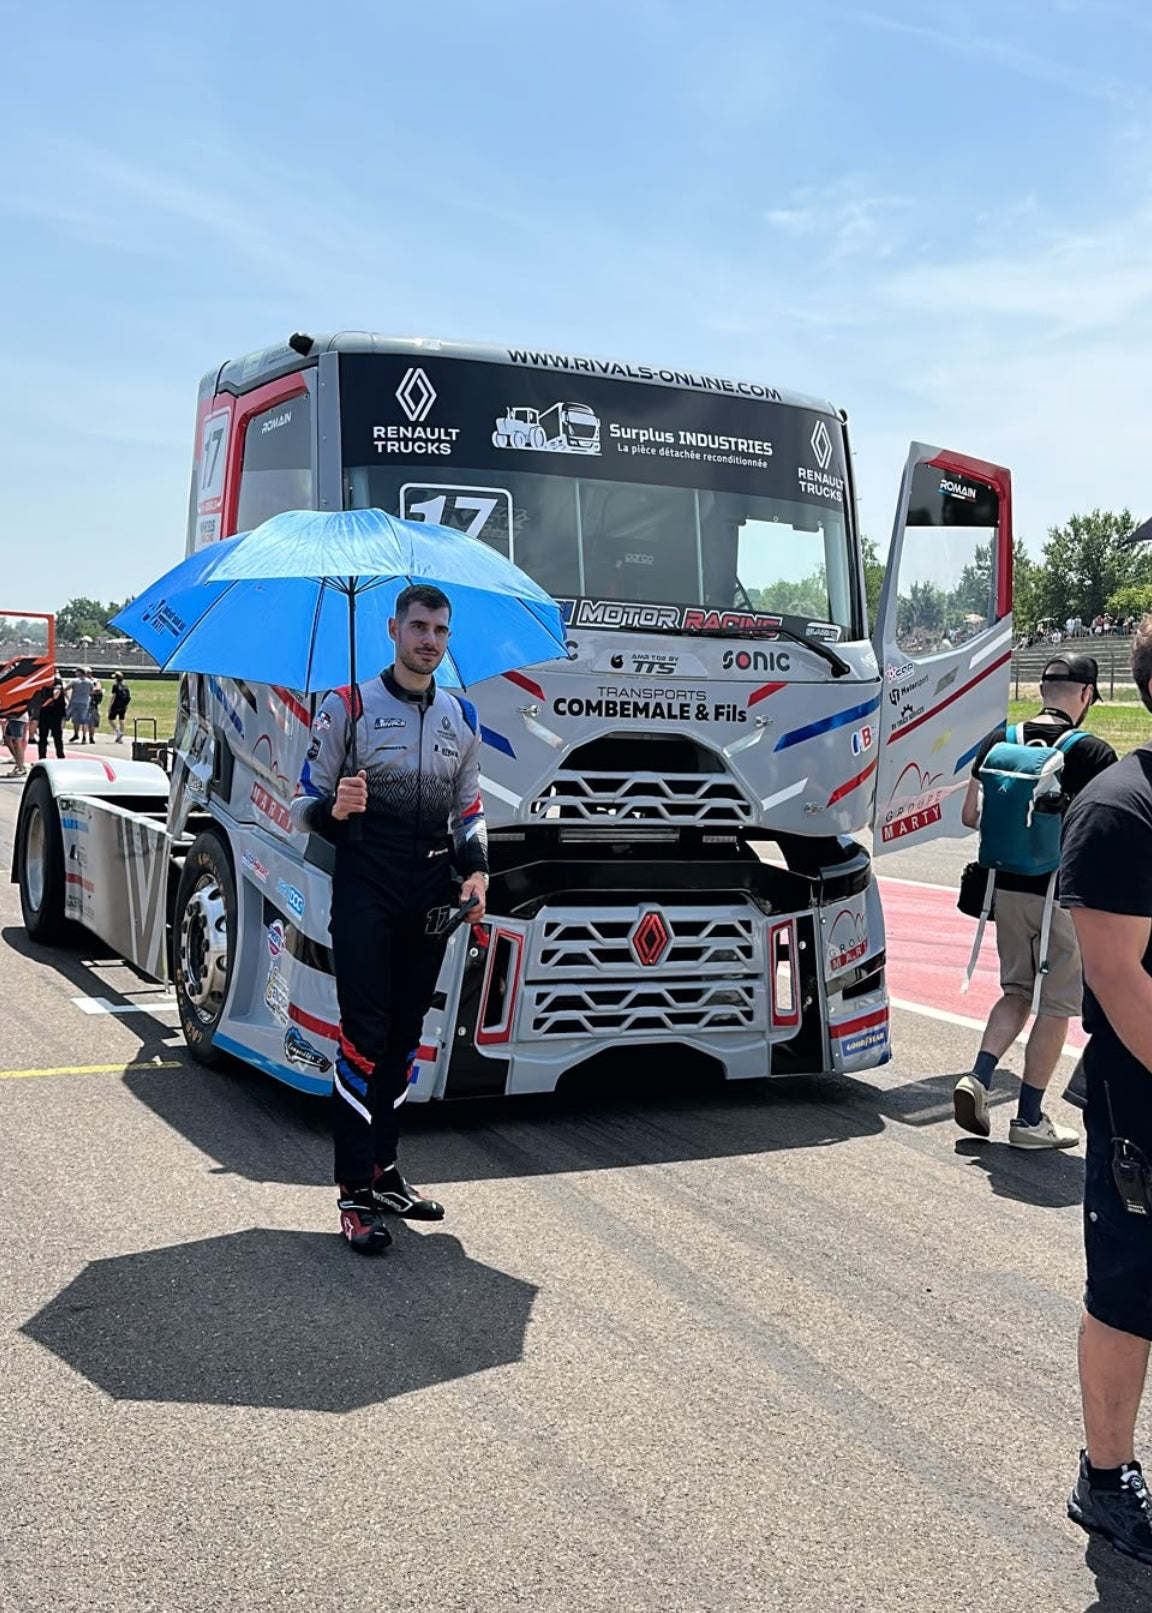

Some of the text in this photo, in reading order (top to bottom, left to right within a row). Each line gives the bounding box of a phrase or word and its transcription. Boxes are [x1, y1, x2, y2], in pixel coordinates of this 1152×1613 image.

[508, 349, 783, 401] WWW.RIVALS-ONLINE.COM
[262, 411, 292, 435] ROMAIN
[373, 426, 460, 441] RENAULT
[373, 440, 452, 455] TRUCKS
[609, 423, 774, 456] Surplus INDUSTRIES
[202, 427, 224, 490] 17
[617, 442, 768, 469] La pièce détachée reconditionnée
[797, 467, 844, 490] RENAULT
[940, 479, 977, 499] ROMAIN
[798, 481, 843, 502] TRUCKS
[410, 495, 498, 539] 17
[580, 603, 678, 629] MOTOR
[632, 660, 677, 675] TTS
[597, 686, 707, 701] TRANSPORTS
[553, 698, 748, 723] COMBEMALE & Fils
[883, 804, 942, 842] MARTY
